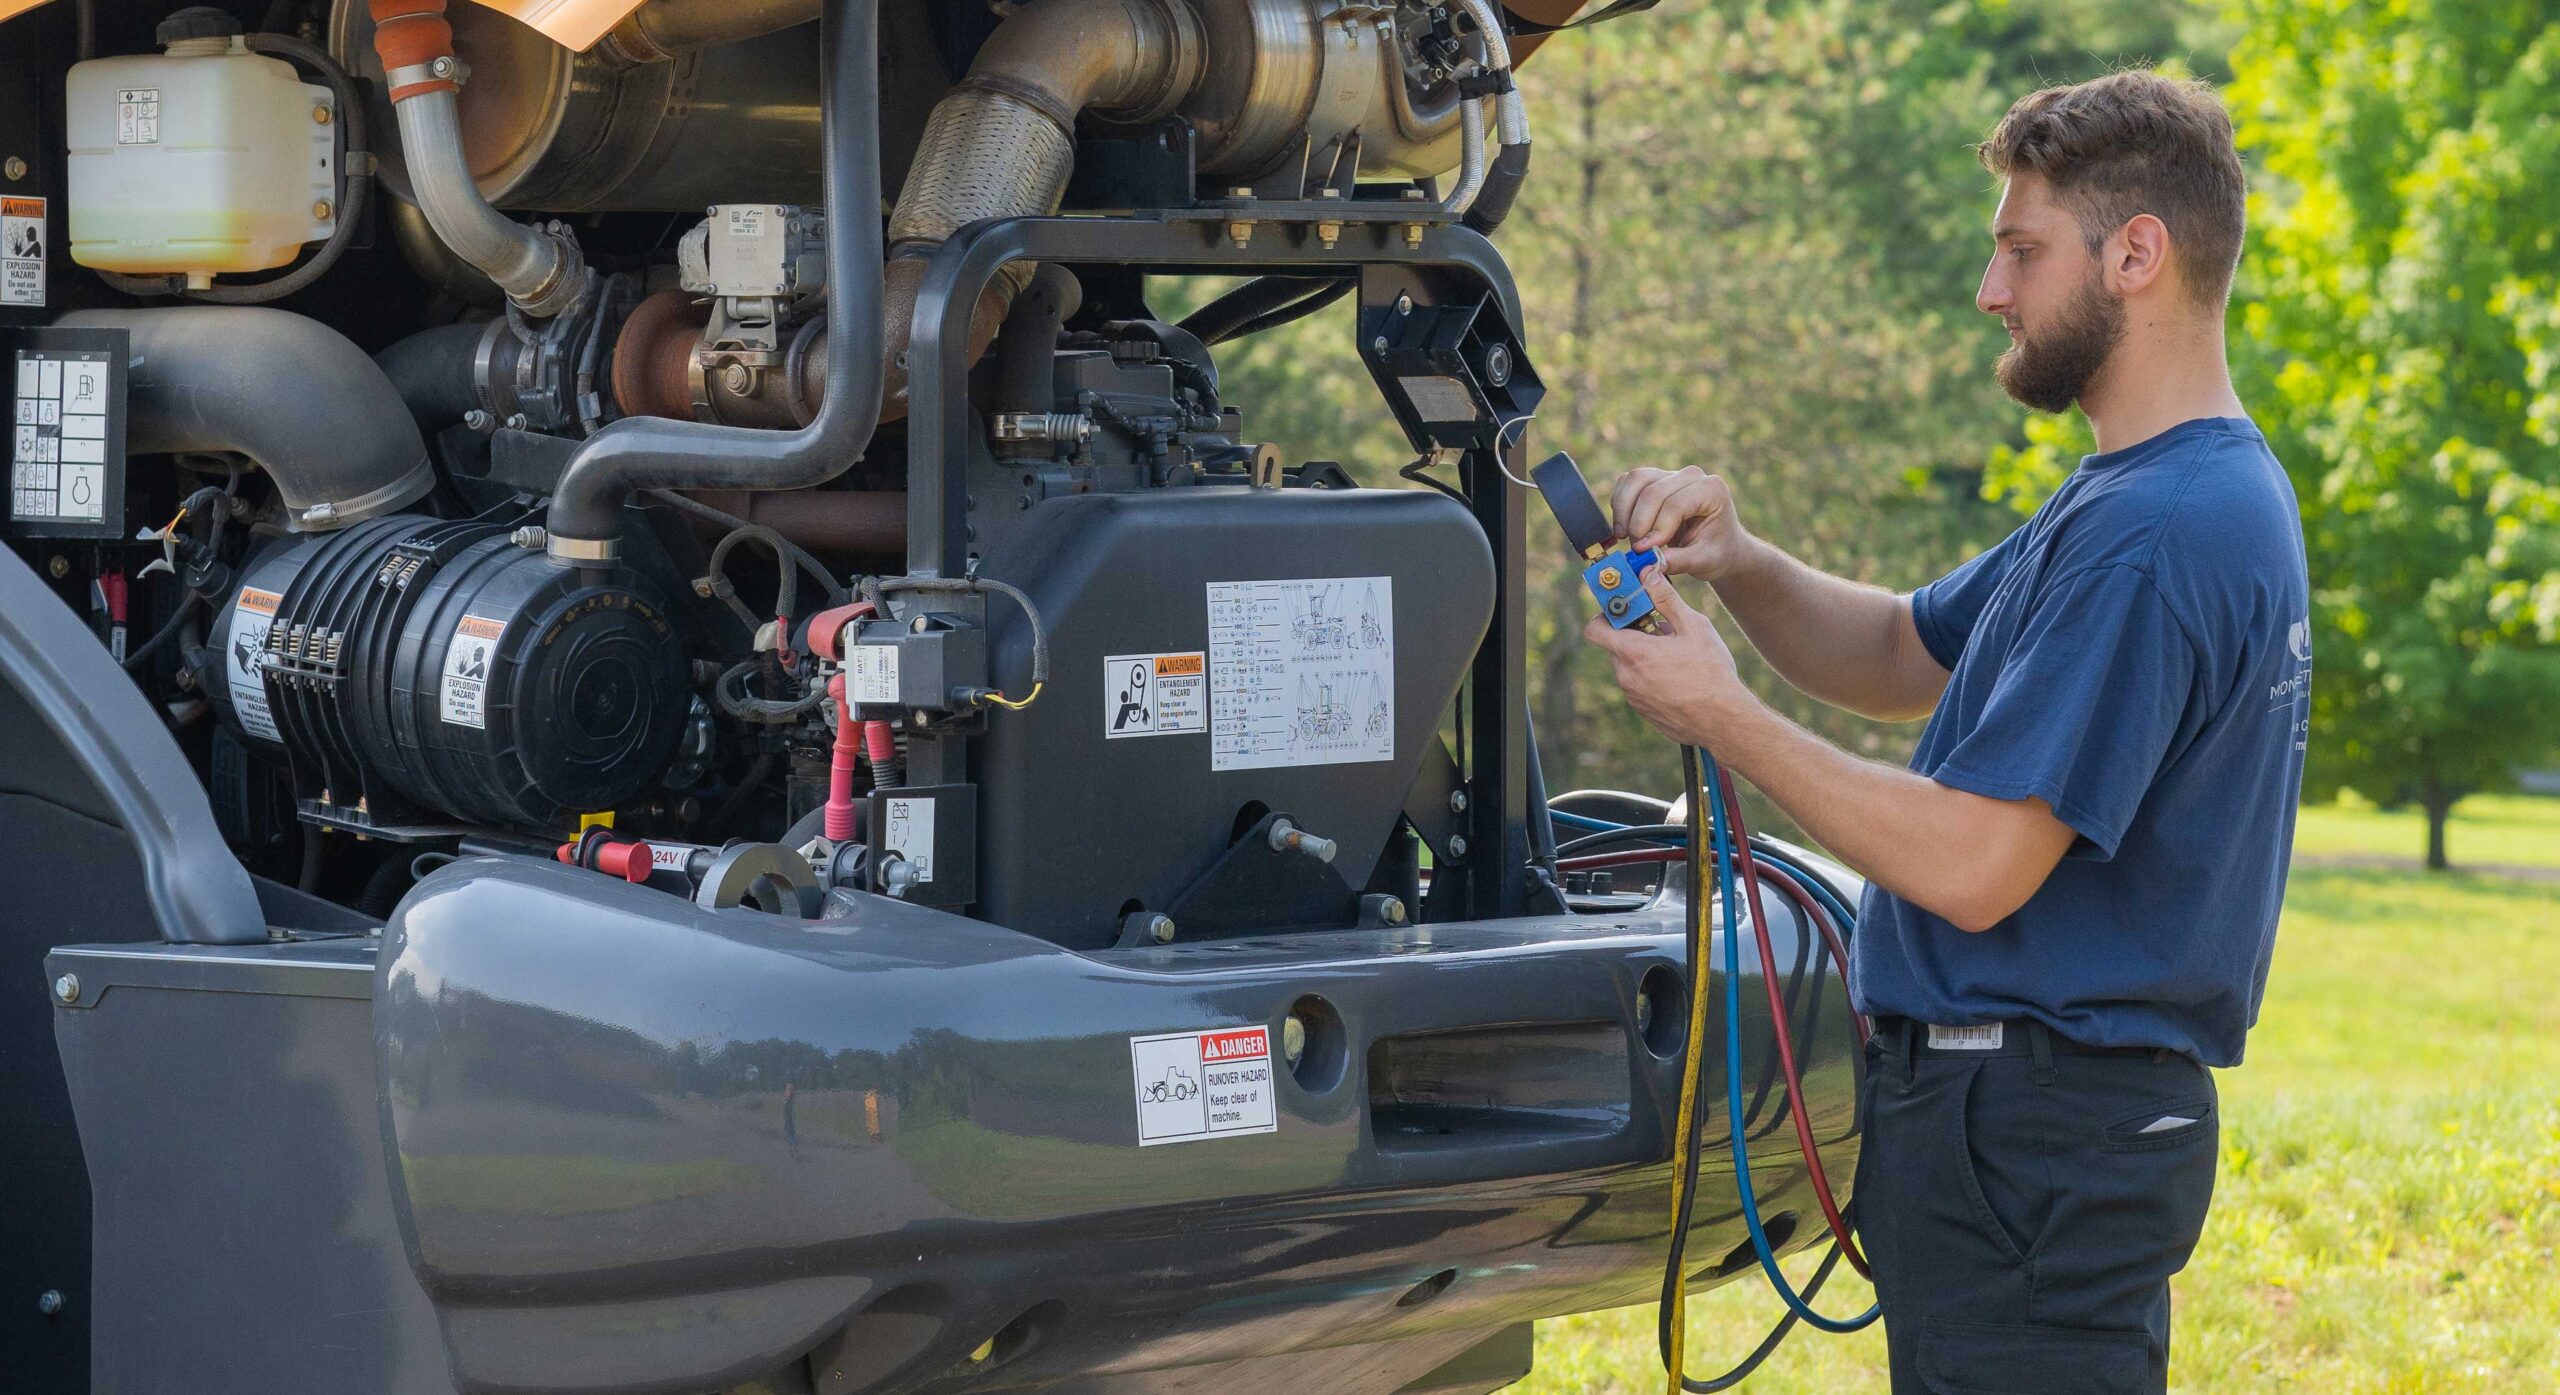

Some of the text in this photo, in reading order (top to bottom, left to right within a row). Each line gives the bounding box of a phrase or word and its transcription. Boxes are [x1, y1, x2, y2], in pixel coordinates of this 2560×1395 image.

[14, 203, 44, 216] WARNING
[6, 261, 41, 271] EXPLOSION
[10, 271, 36, 280] HAZARD
[15, 288, 29, 296] ether.
[471, 623, 500, 638] WARNING
[1167, 658, 1201, 672] WARNING
[449, 679, 480, 692] EXPLOSION
[1159, 678, 1200, 689] ENTANGLEMENT
[452, 690, 475, 701] HAZARD
[1169, 688, 1191, 697] HAZARD
[455, 709, 469, 717] ether.
[653, 850, 678, 865] 24V
[1221, 1036, 1265, 1056] DANGER
[1208, 1069, 1267, 1086] RUNOVER HAZARD
[1210, 1089, 1257, 1107] Keep clear of
[1212, 1110, 1242, 1123] machine.
